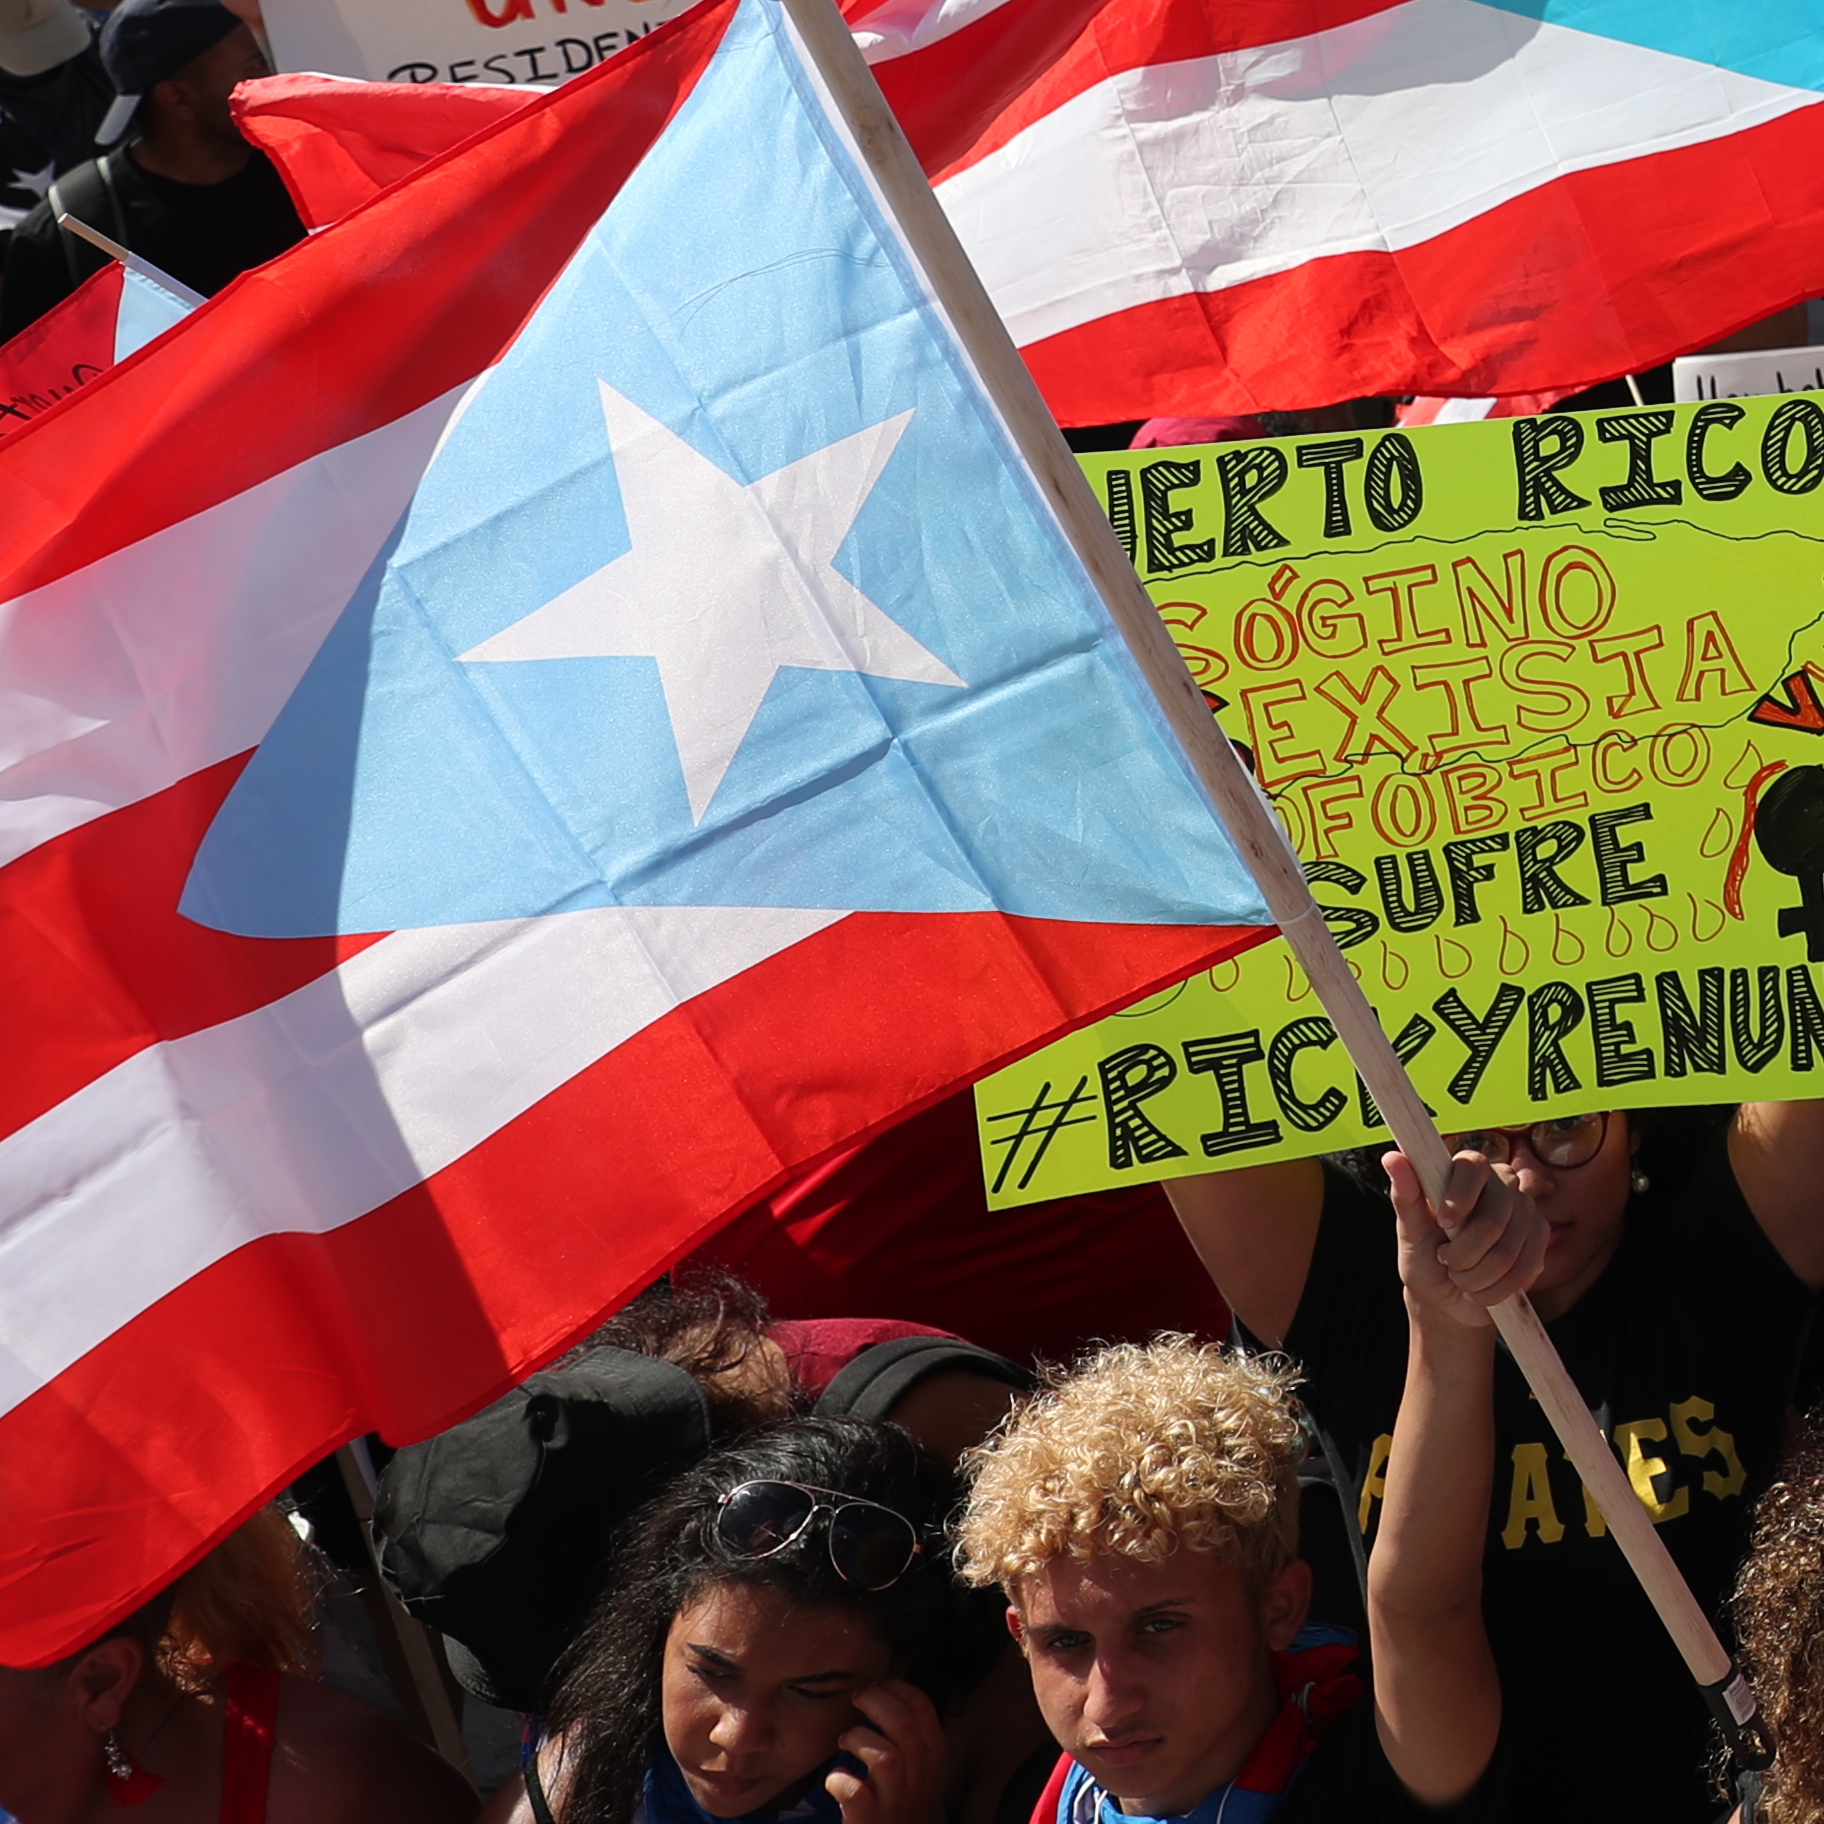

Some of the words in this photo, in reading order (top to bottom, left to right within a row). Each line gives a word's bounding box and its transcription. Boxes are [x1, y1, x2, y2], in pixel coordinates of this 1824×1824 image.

[1105, 431, 1424, 575] UERTO
[1155, 543, 1618, 688] SÓGINO
[1202, 609, 1759, 790] EXISTA
[1268, 721, 1712, 861] OFÓBICO
[1303, 801, 1668, 949] SUFRE
